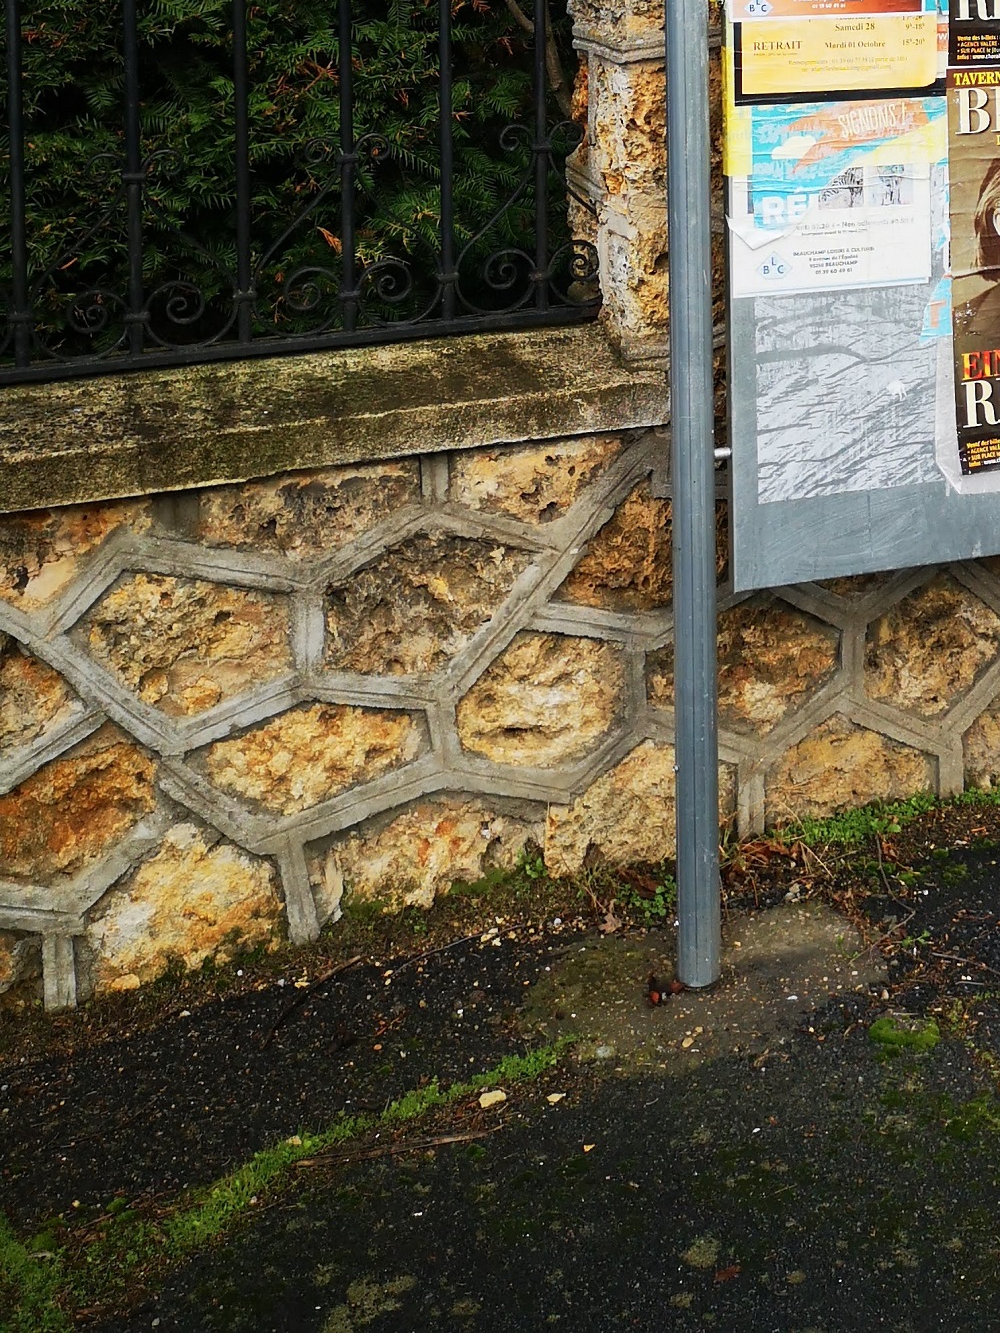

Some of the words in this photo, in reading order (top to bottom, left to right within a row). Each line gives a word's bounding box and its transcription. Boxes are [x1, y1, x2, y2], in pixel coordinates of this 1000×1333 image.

[835, 22, 865, 32] Samedi
[866, 22, 876, 31] 28
[753, 40, 803, 51] RETRAIT
[825, 41, 847, 49] Mardi
[857, 40, 886, 49] Octobre
[838, 101, 897, 139] SIGNONS
